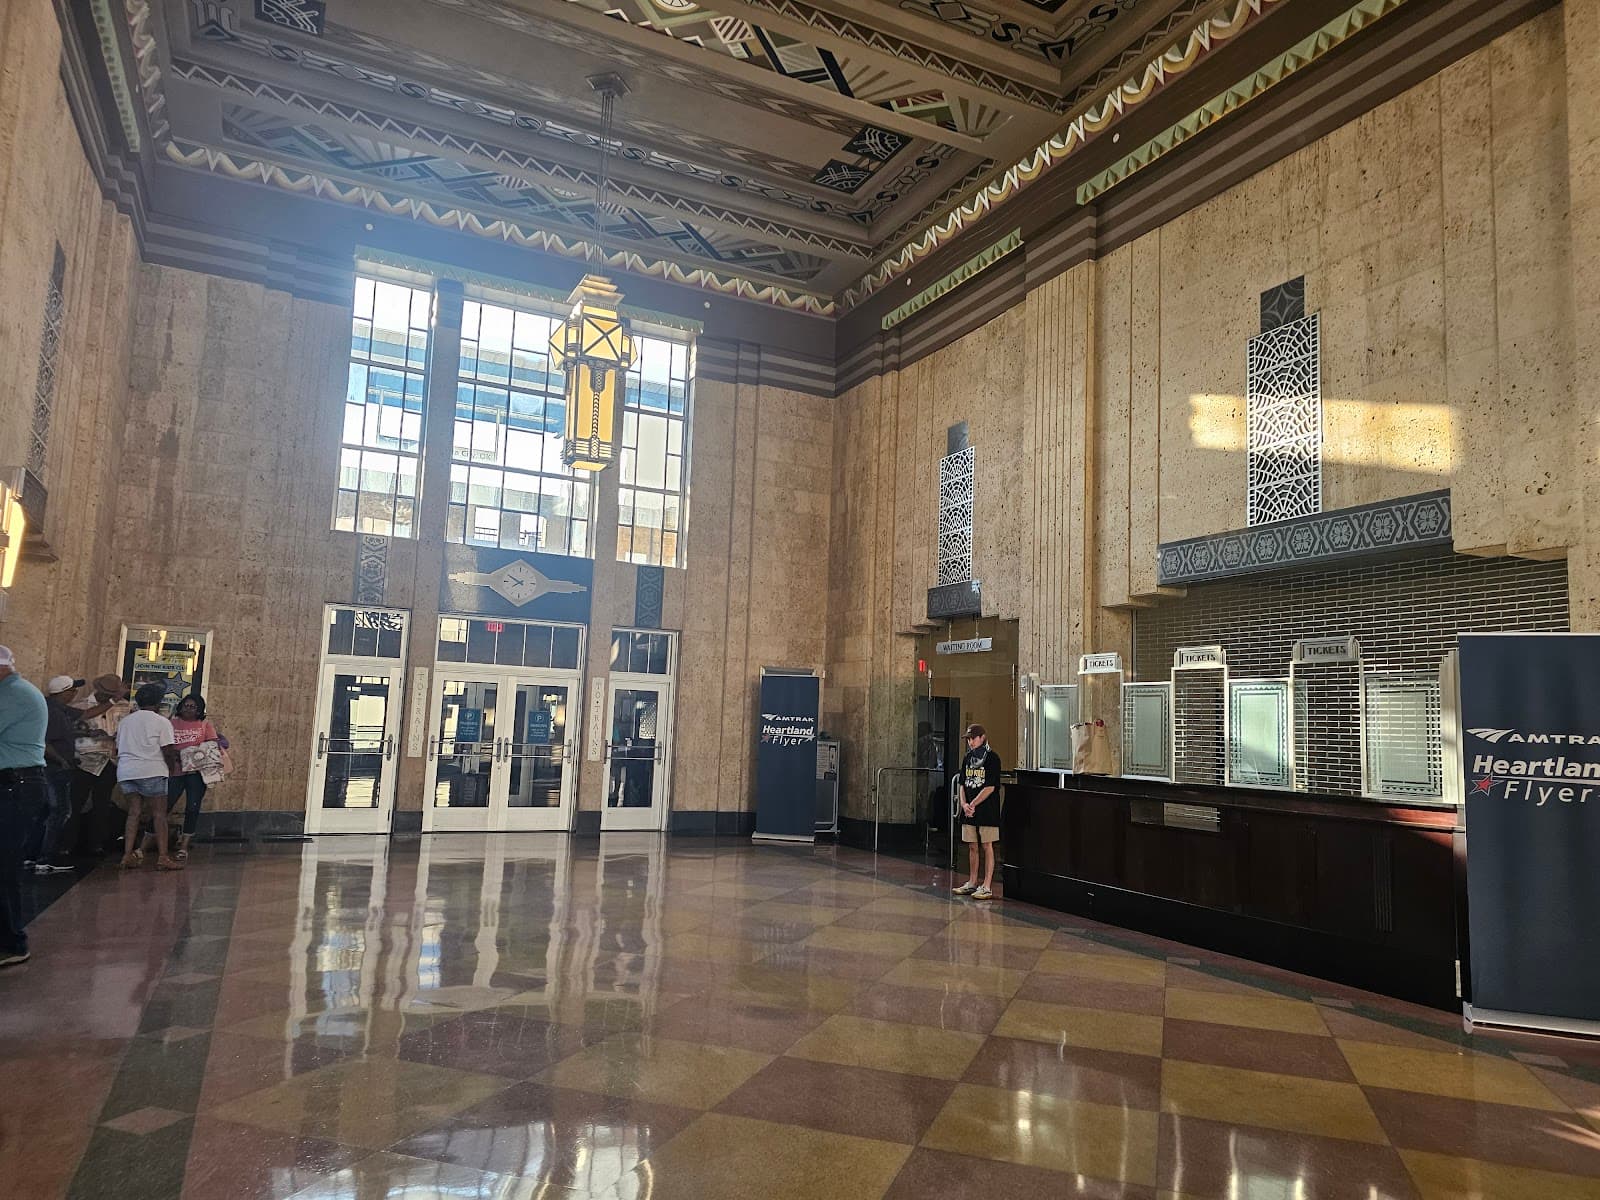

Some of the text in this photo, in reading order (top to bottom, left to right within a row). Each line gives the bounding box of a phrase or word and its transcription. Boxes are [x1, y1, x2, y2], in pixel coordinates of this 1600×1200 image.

[1306, 645, 1347, 656] TICKETS
[1089, 659, 1114, 668] TICKETS
[1184, 653, 1216, 663] TICKETS
[762, 725, 814, 736] Heartland
[772, 735, 803, 747] Flyer
[1503, 780, 1593, 806] Flyer
